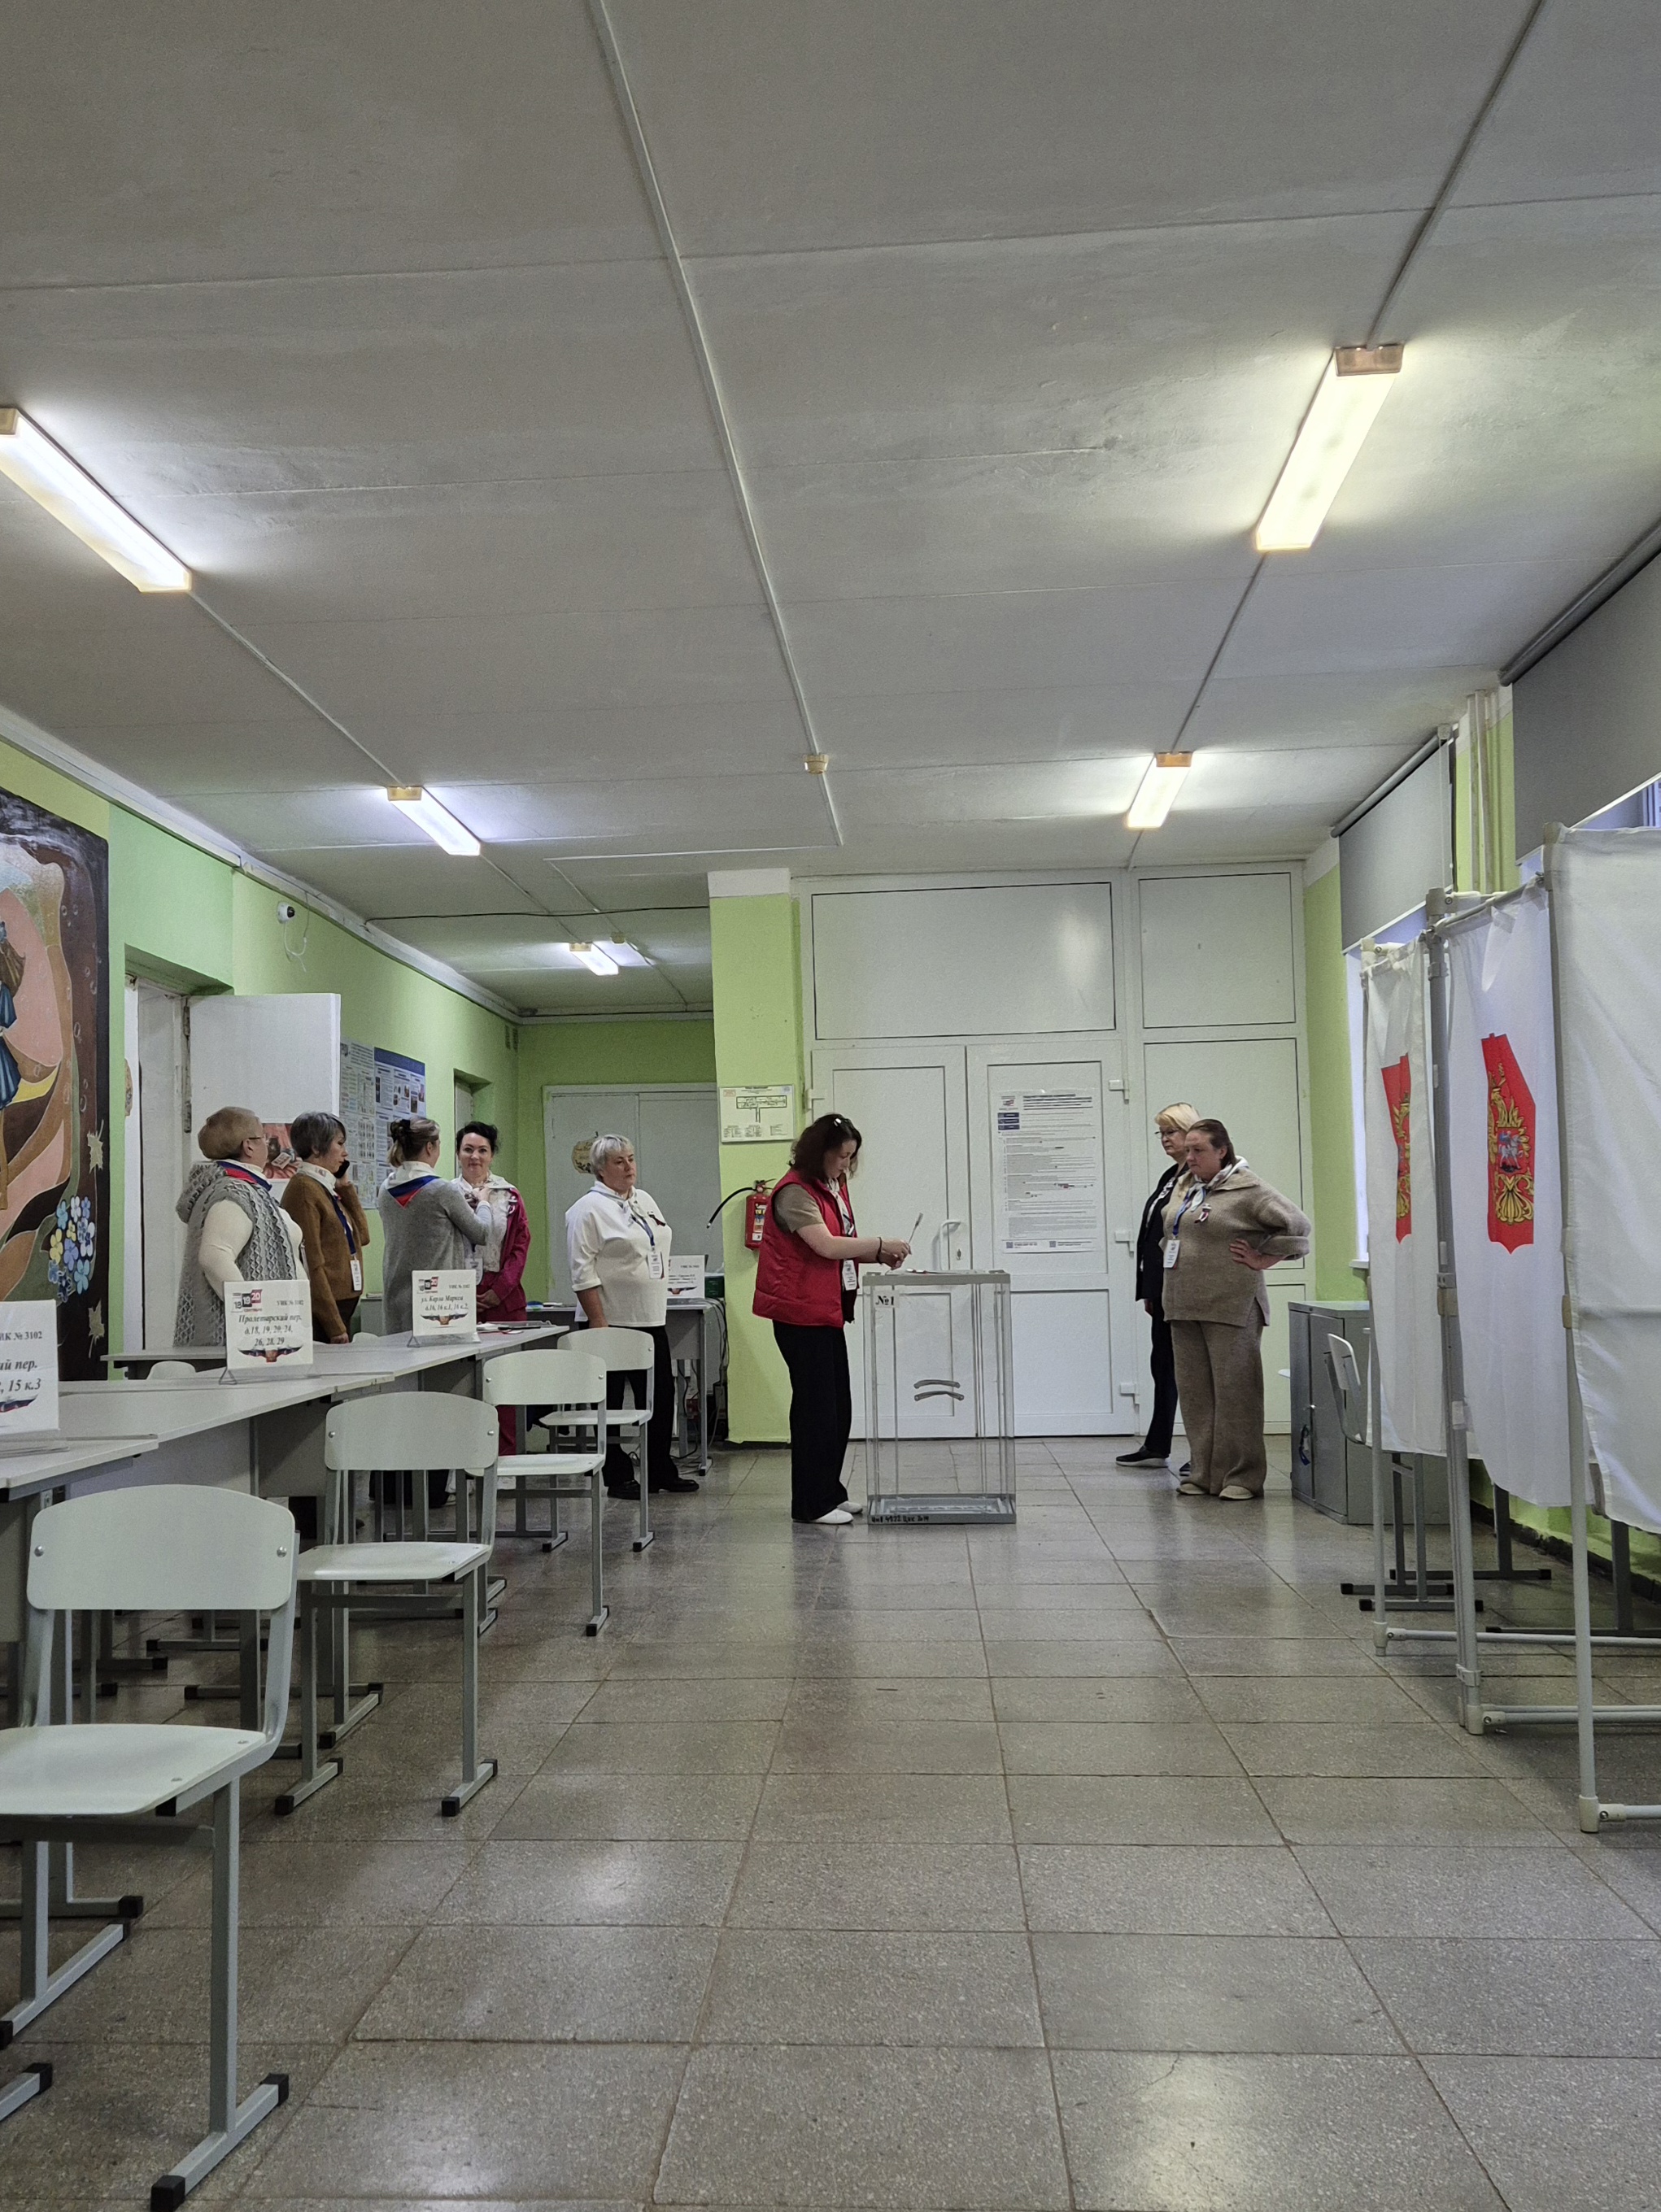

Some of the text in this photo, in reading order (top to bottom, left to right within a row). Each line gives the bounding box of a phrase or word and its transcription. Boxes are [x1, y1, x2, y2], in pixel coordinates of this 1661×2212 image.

[251, 1292, 261, 1301] 20
[875, 1295, 894, 1306] №1
[238, 1313, 302, 1324] Пролетарский пер.
[13, 1332, 23, 1340] №
[24, 1331, 43, 1340] 3102
[244, 1326, 260, 1335] д.18,
[263, 1326, 272, 1334] 19,
[254, 1338, 264, 1347] 26,
[277, 1337, 285, 1345] 29
[15, 1360, 38, 1372] пер.
[8, 1379, 22, 1392] 15
[24, 1378, 41, 1391] к.3
